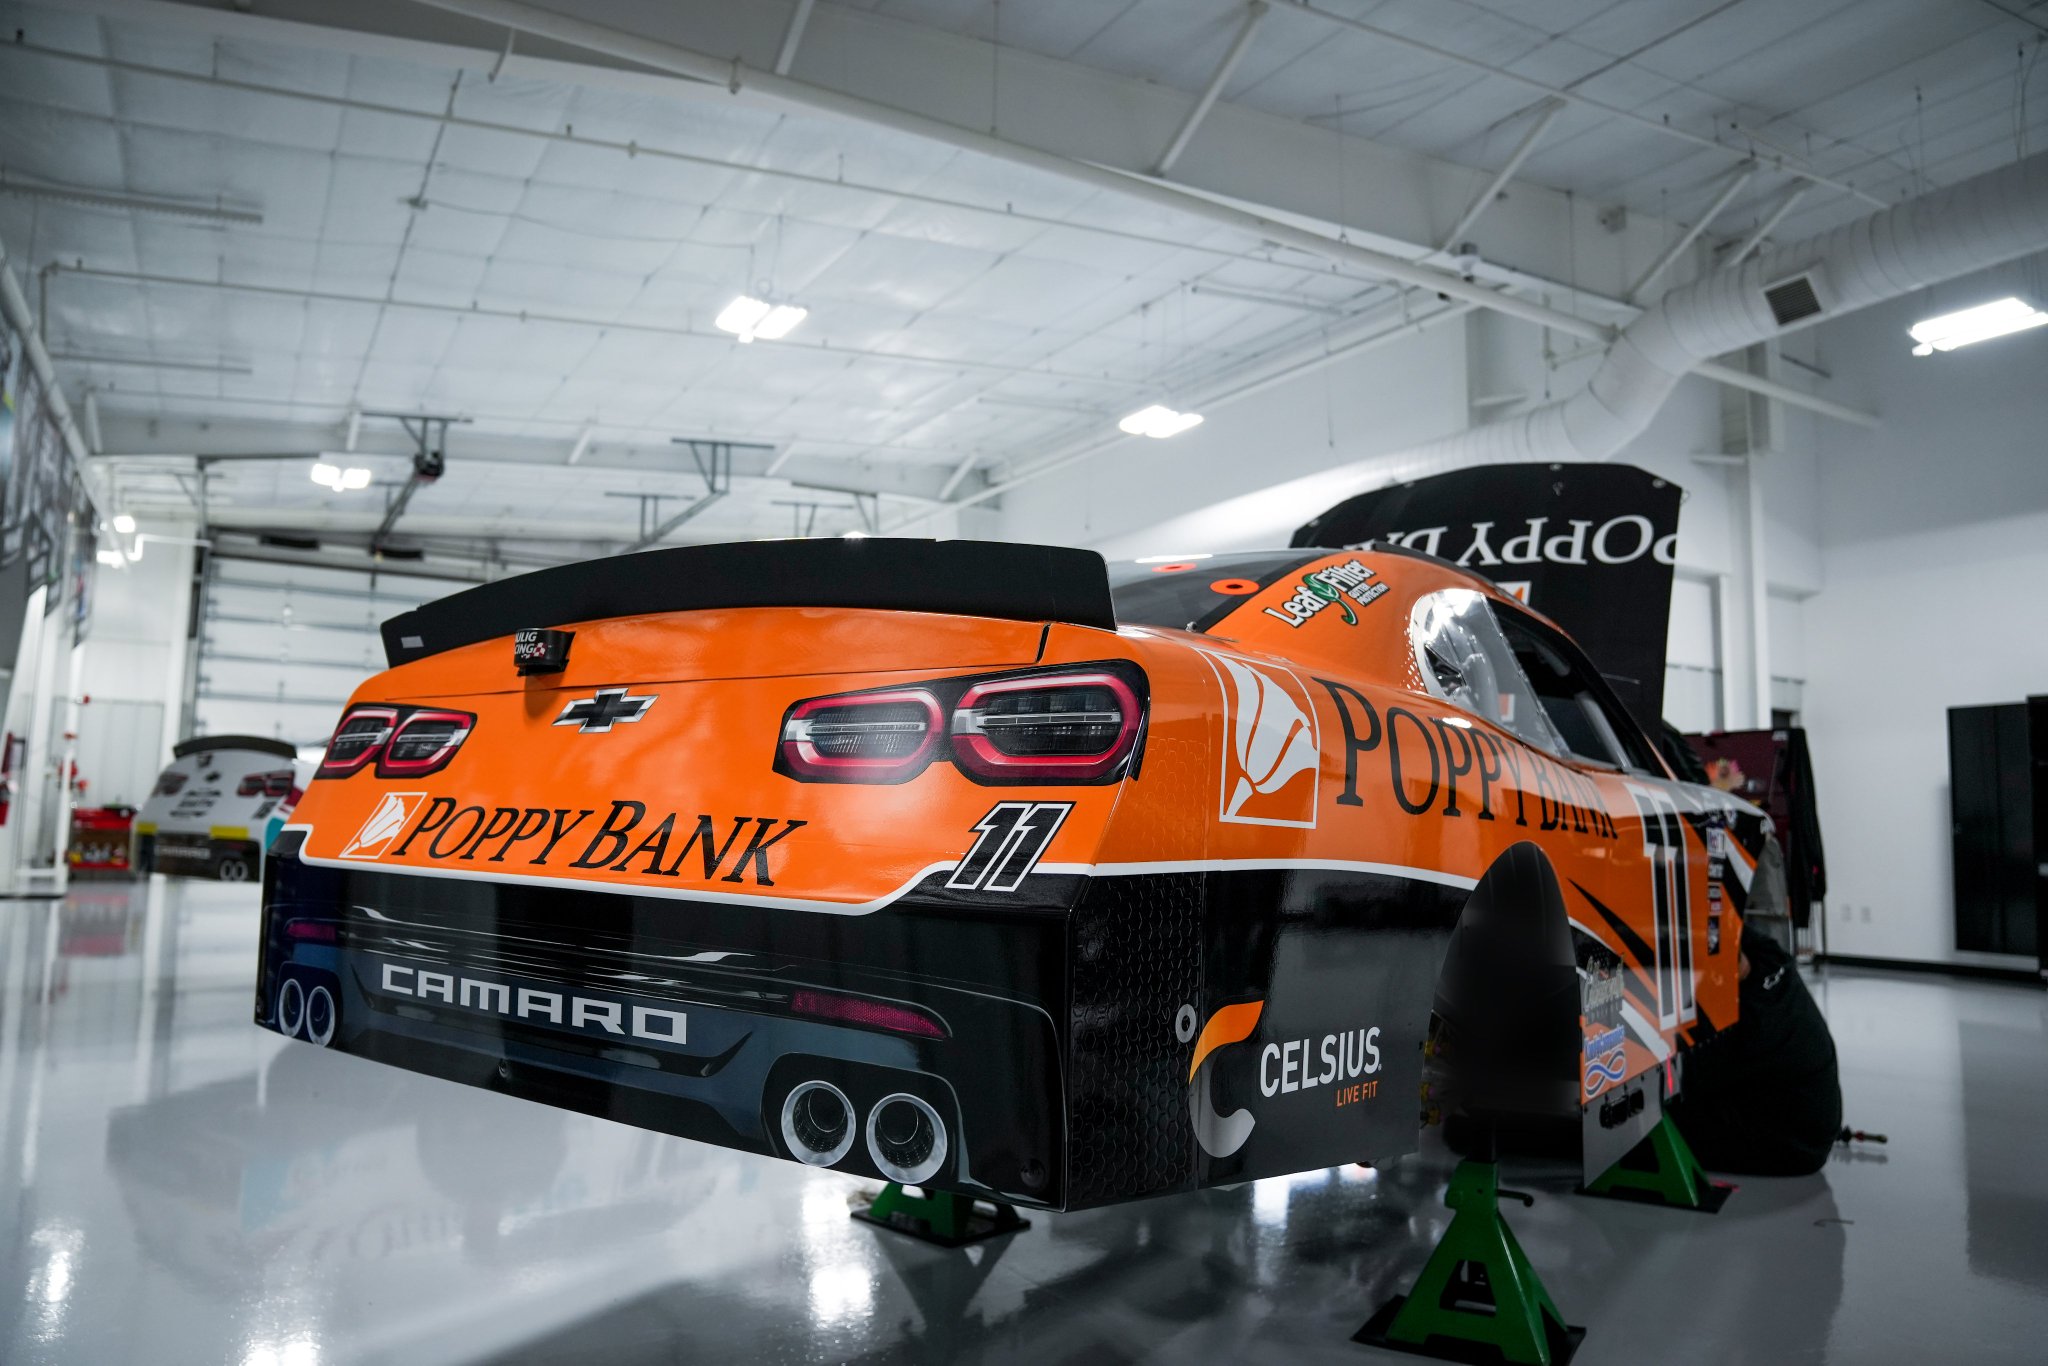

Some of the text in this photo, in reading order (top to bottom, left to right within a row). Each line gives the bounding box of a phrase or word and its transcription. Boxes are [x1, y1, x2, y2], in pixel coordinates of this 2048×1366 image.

[1312, 677, 1618, 840] POPPY BANK
[391, 797, 808, 887] POPPY BANK
[944, 801, 1077, 893] 11
[1624, 782, 1697, 1031] 11
[382, 963, 687, 1045] CAMARO
[1336, 1080, 1378, 1107] LIVE FIT
